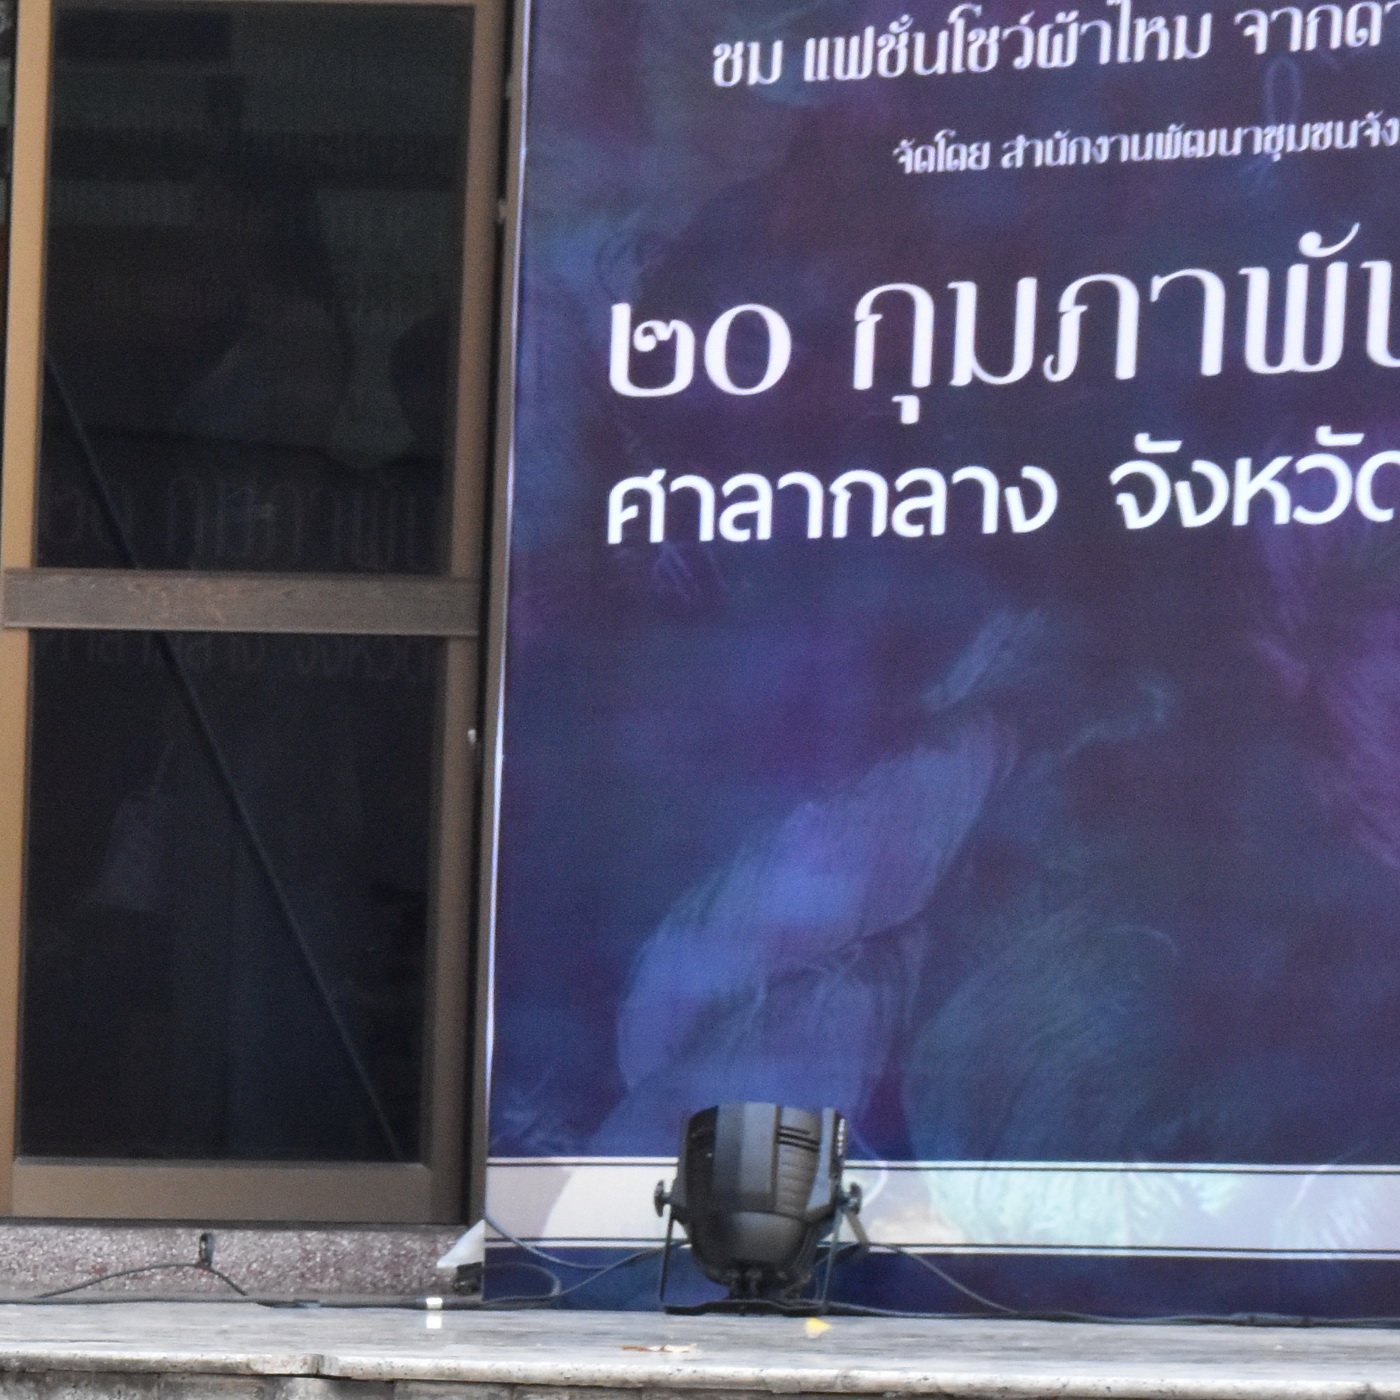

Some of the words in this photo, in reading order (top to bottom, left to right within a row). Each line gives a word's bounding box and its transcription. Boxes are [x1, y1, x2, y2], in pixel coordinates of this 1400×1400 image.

[713, 39, 784, 87] ชม
[894, 128, 992, 174] จัดโดย
[609, 302, 792, 397] ๒๐
[607, 465, 1058, 545] ศาลากลาง
